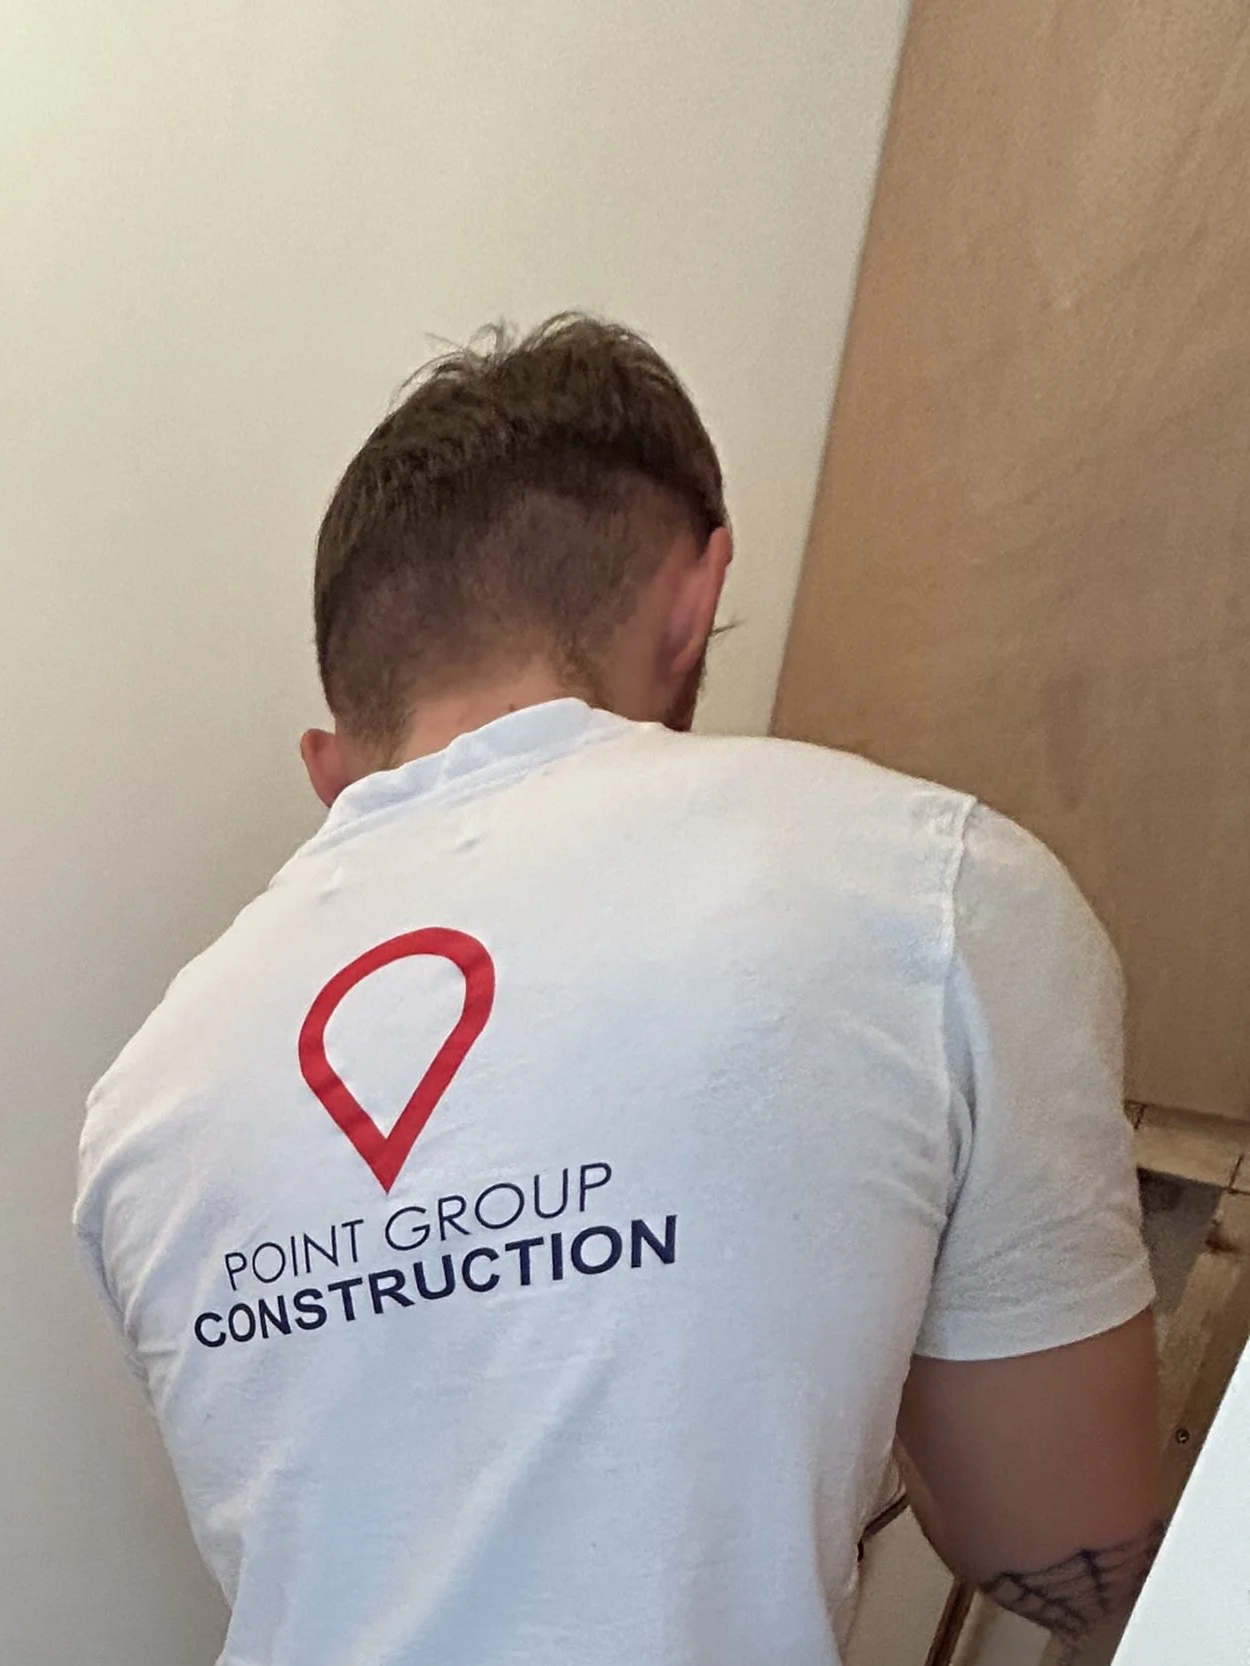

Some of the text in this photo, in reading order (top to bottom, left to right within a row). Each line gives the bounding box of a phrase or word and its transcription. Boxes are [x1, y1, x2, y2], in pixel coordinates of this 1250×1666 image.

[193, 1214, 678, 1348] CONSTRUCTION
[224, 1161, 613, 1292] POINT GROUP
